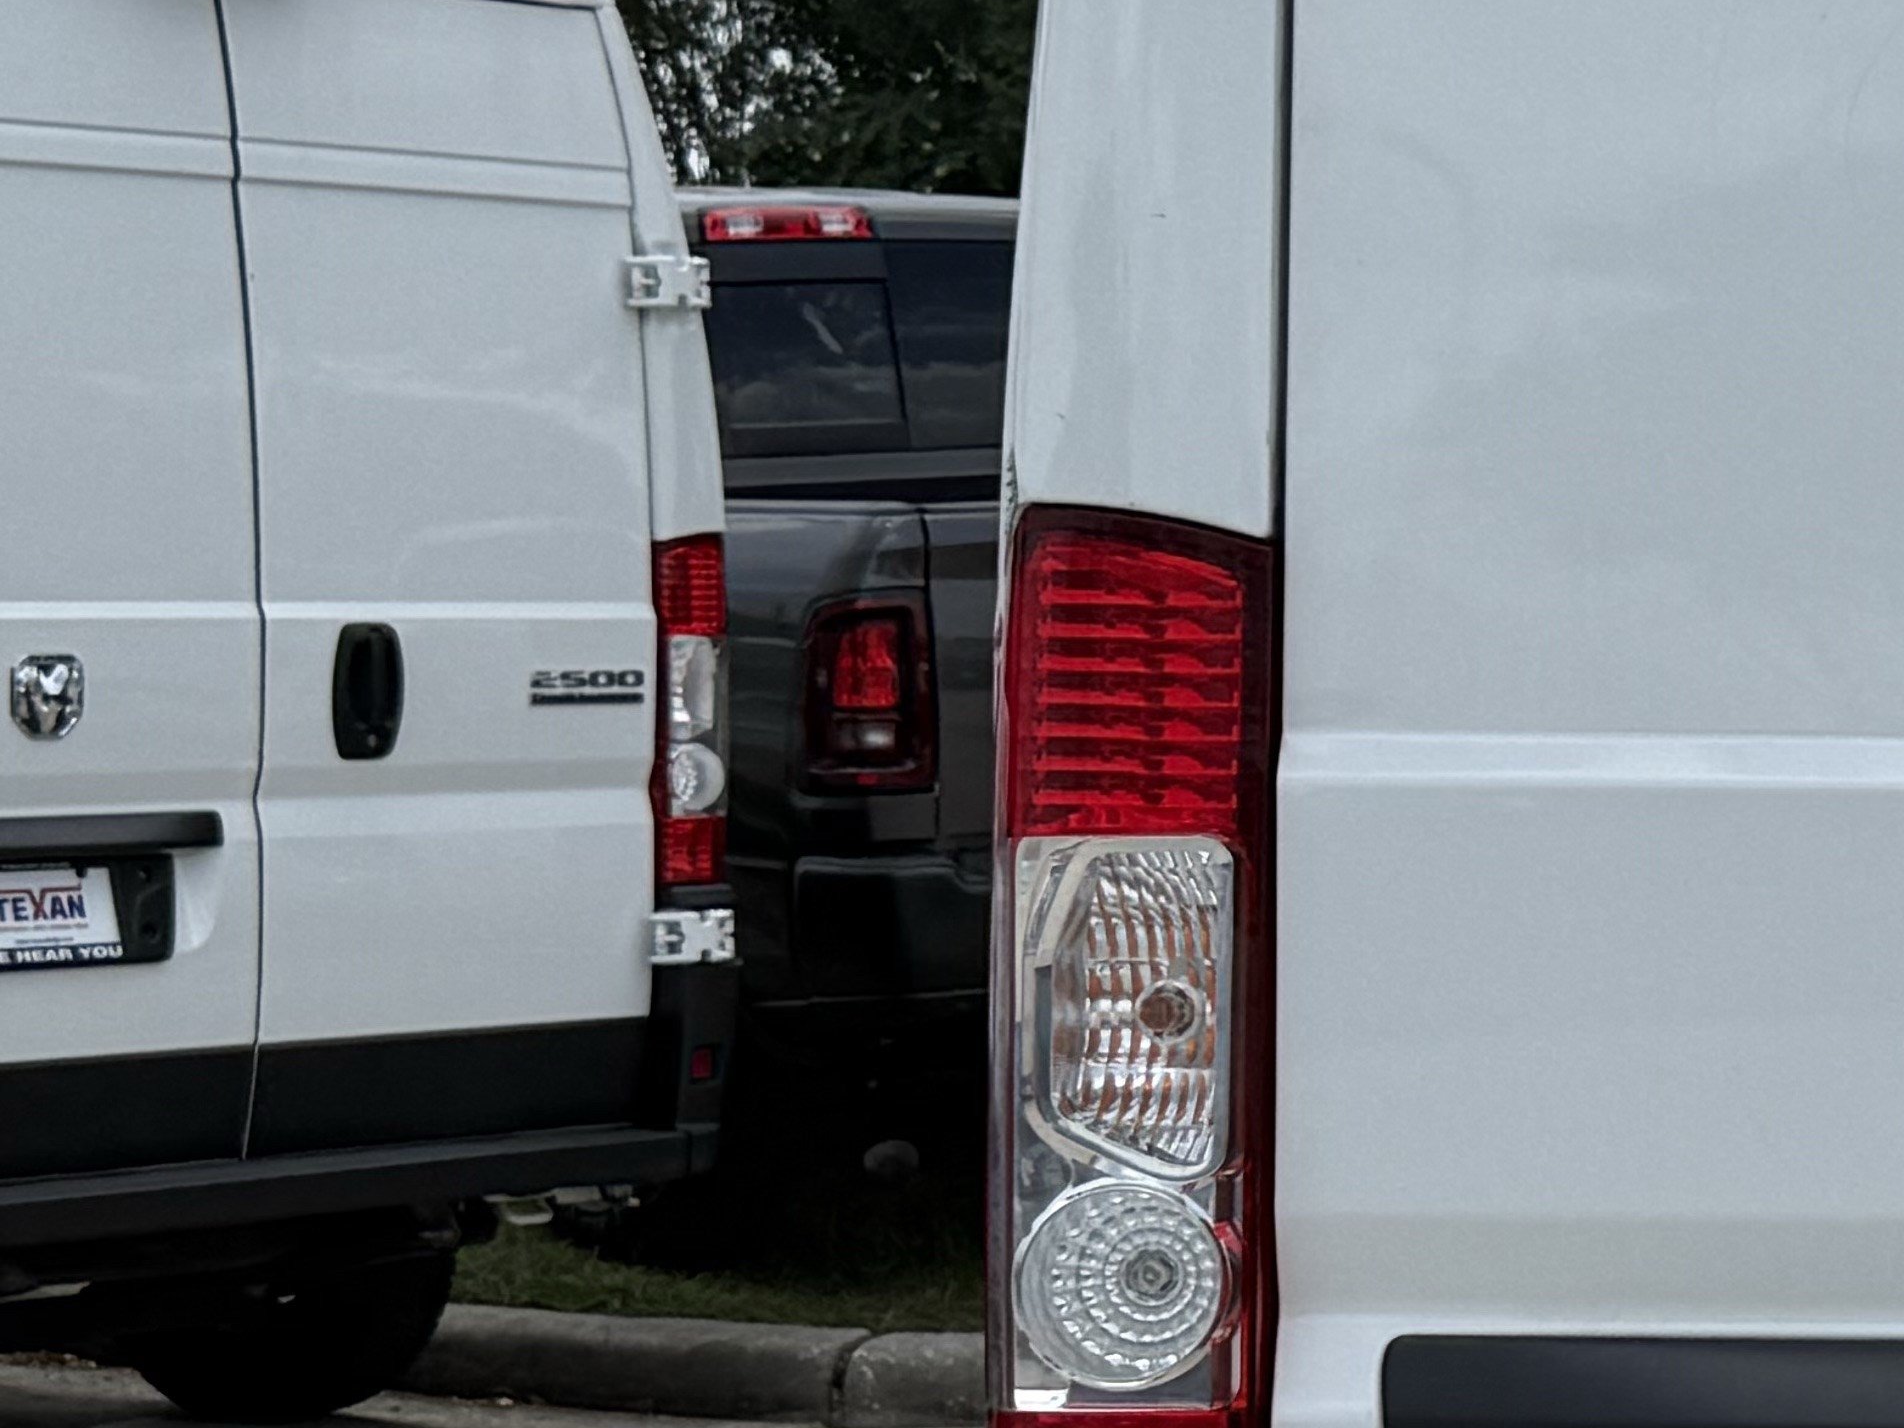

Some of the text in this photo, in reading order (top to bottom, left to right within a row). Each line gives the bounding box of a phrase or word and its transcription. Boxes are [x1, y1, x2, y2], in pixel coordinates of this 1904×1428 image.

[530, 670, 645, 688] 2500
[16, 947, 73, 963] HEAR
[79, 945, 123, 959] YOU
